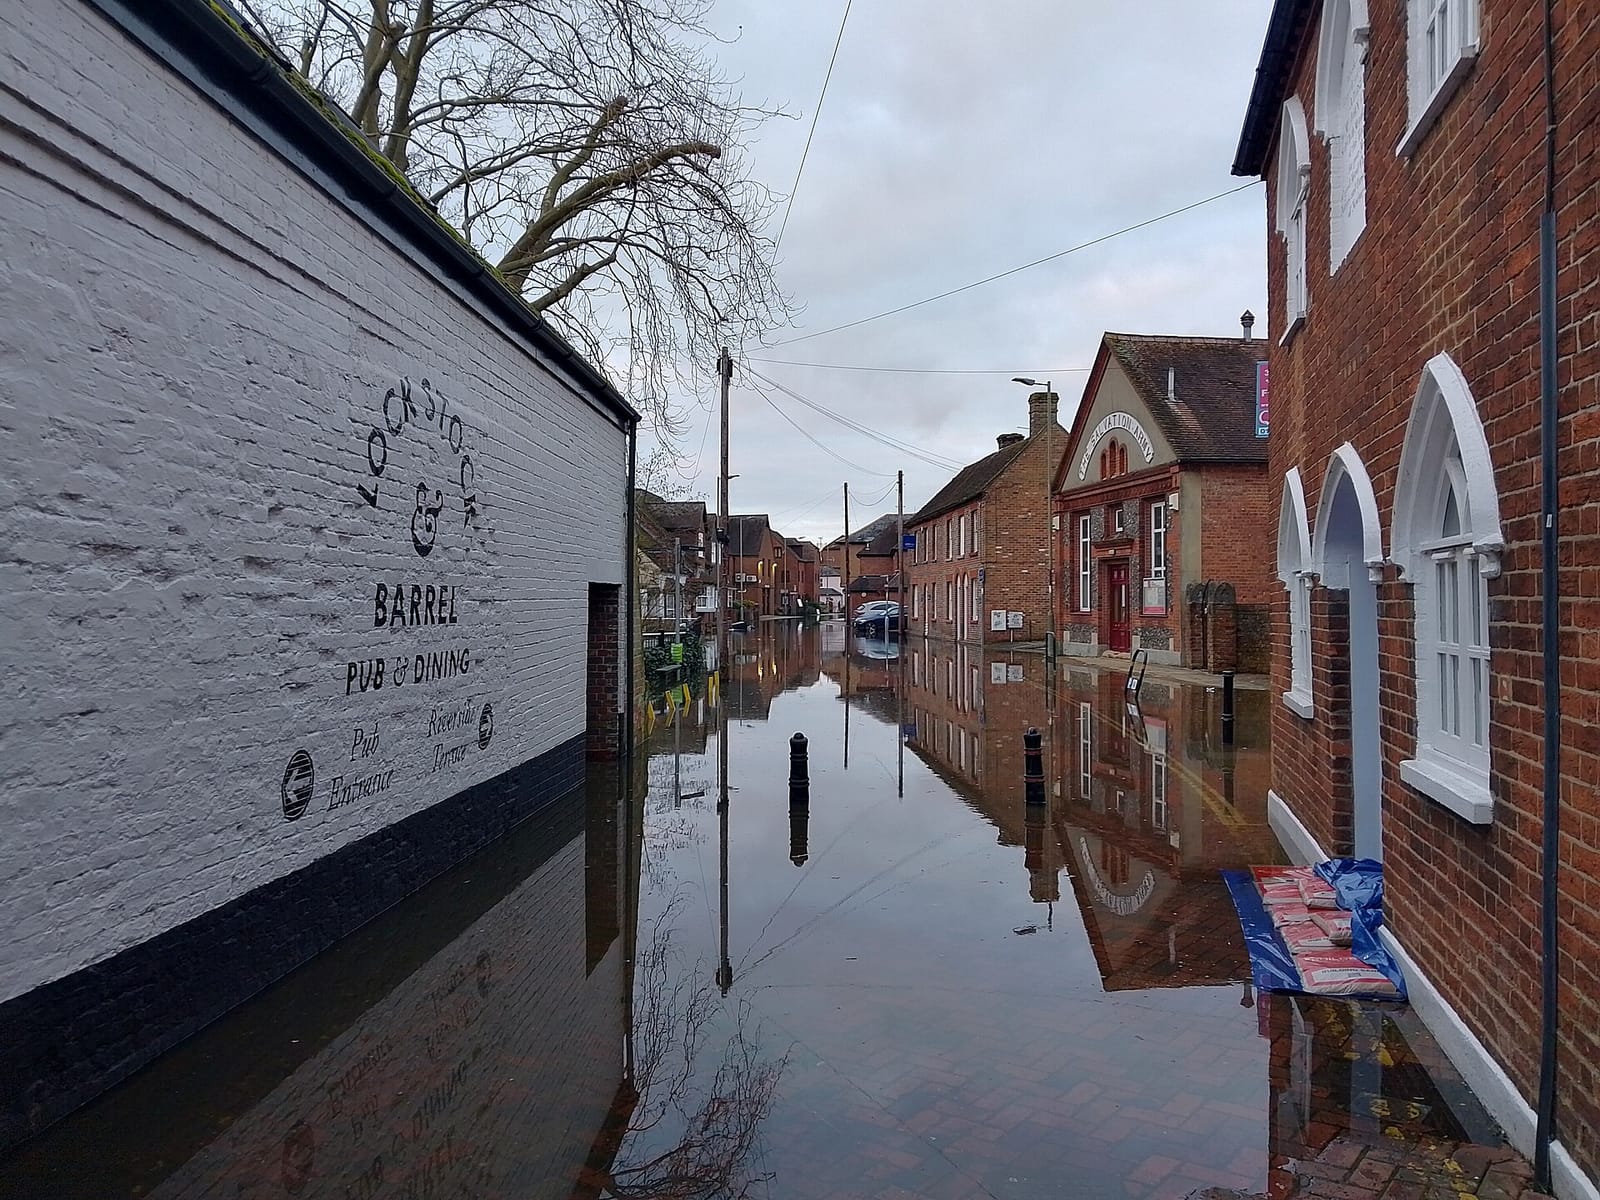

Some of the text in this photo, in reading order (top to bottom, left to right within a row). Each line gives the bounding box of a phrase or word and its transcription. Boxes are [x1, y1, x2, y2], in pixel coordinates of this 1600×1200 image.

[1090, 413, 1133, 447] SALVATION
[1133, 425, 1152, 458] ARMY
[411, 482, 443, 557] &
[374, 583, 459, 627] BARREL
[346, 648, 470, 695] PUB & DINING
[427, 699, 475, 737] Riverside
[350, 722, 380, 762] Pub
[326, 769, 394, 812] Entrance
